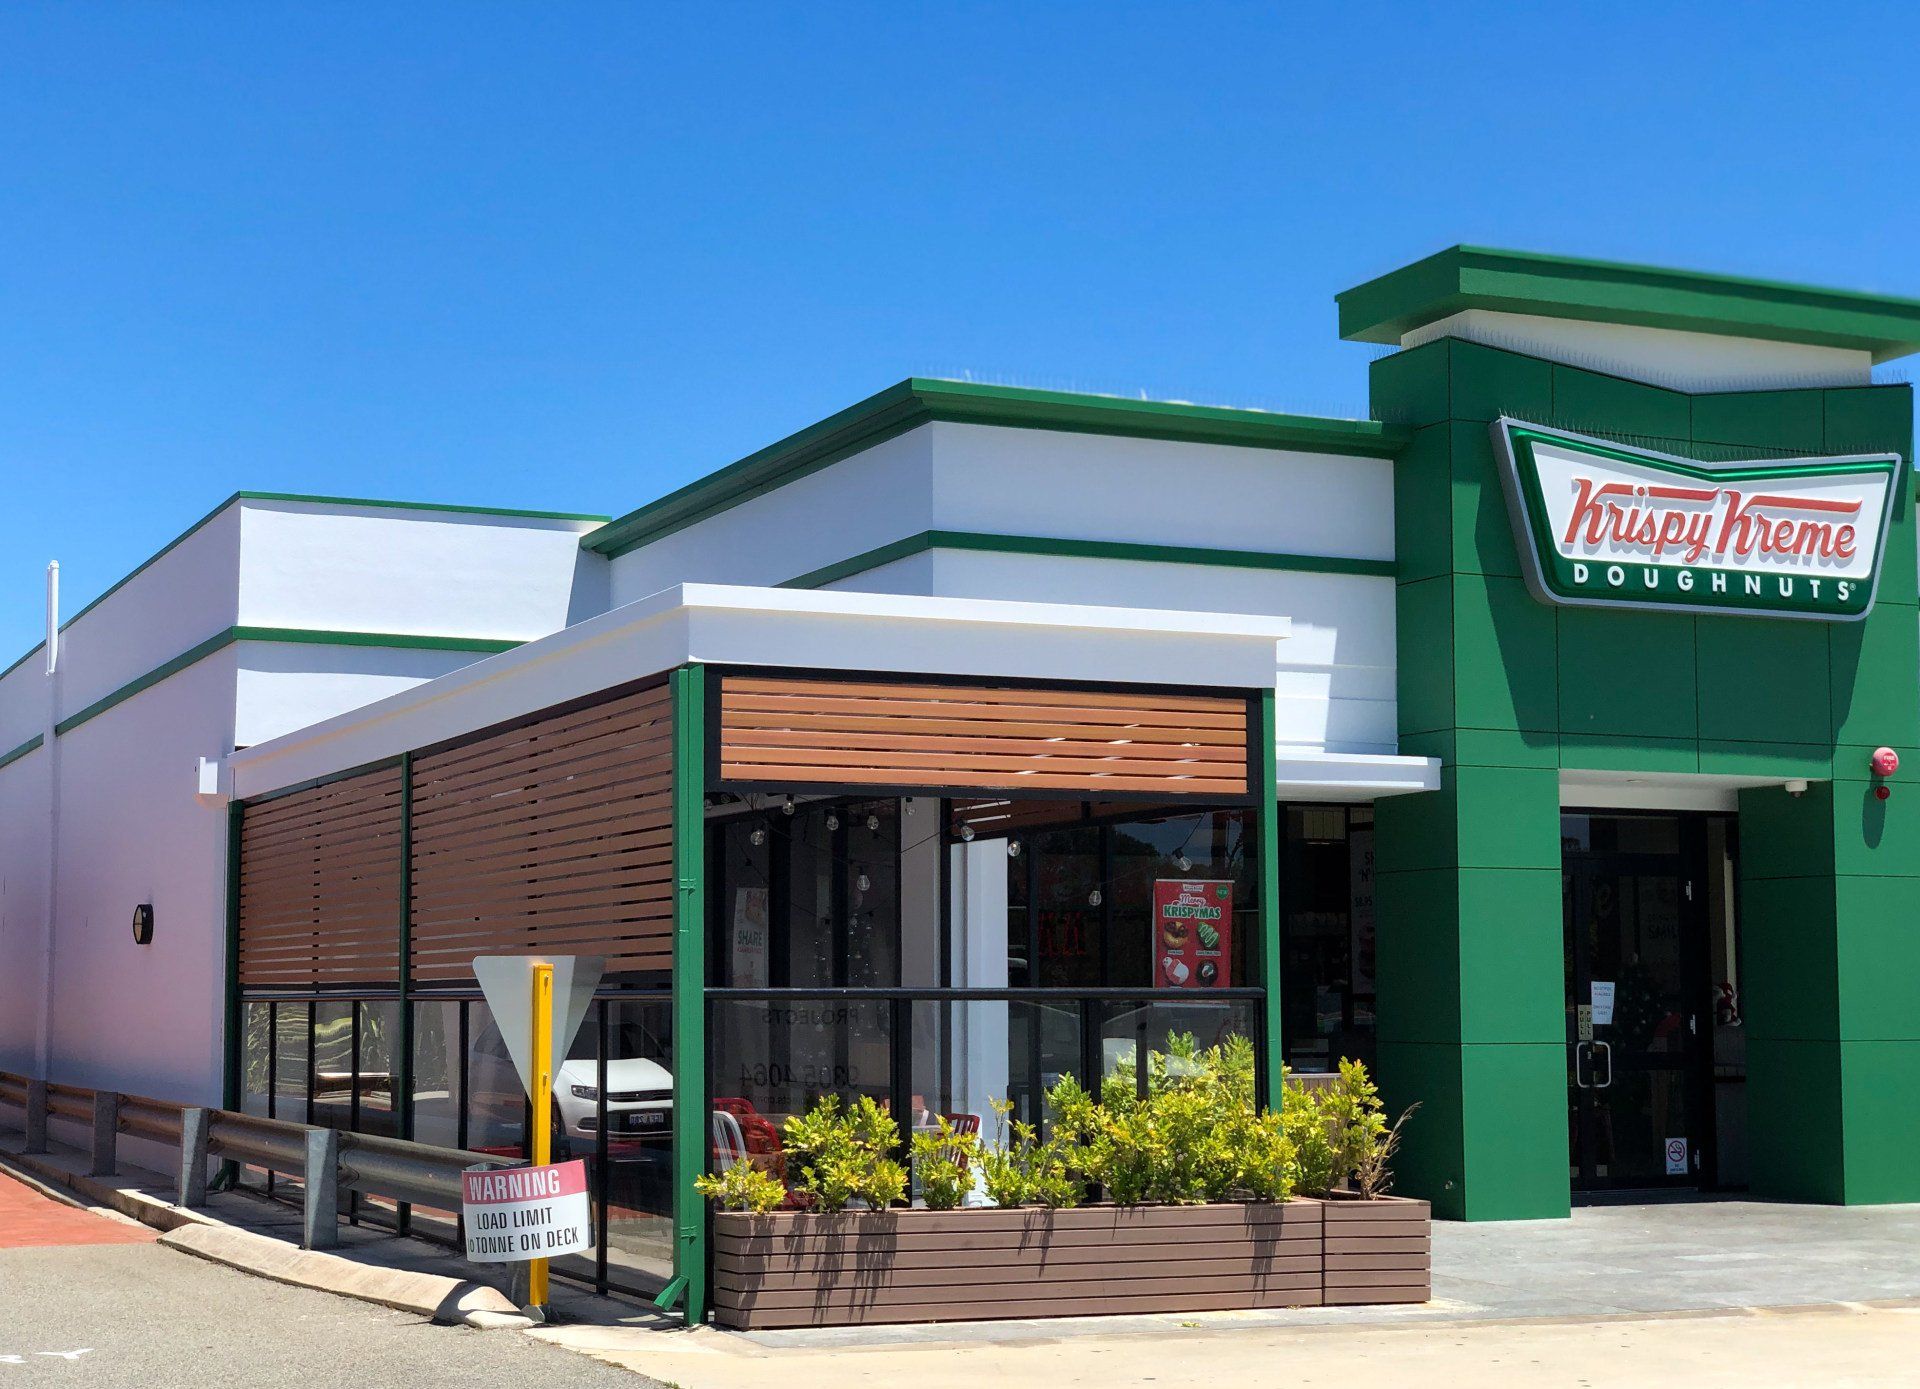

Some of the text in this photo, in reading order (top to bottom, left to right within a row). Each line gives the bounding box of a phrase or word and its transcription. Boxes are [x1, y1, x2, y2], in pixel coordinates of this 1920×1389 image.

[1564, 478, 1863, 564] Krispy Kreme
[1163, 906, 1221, 919] KRISPYMAS
[738, 930, 762, 946] SHARE
[469, 1169, 560, 1201] WARNING
[477, 1206, 552, 1230] LOAD LIMIT
[475, 1235, 515, 1254] TONNE
[520, 1232, 541, 1251] ON
[546, 1226, 580, 1248] DECK
